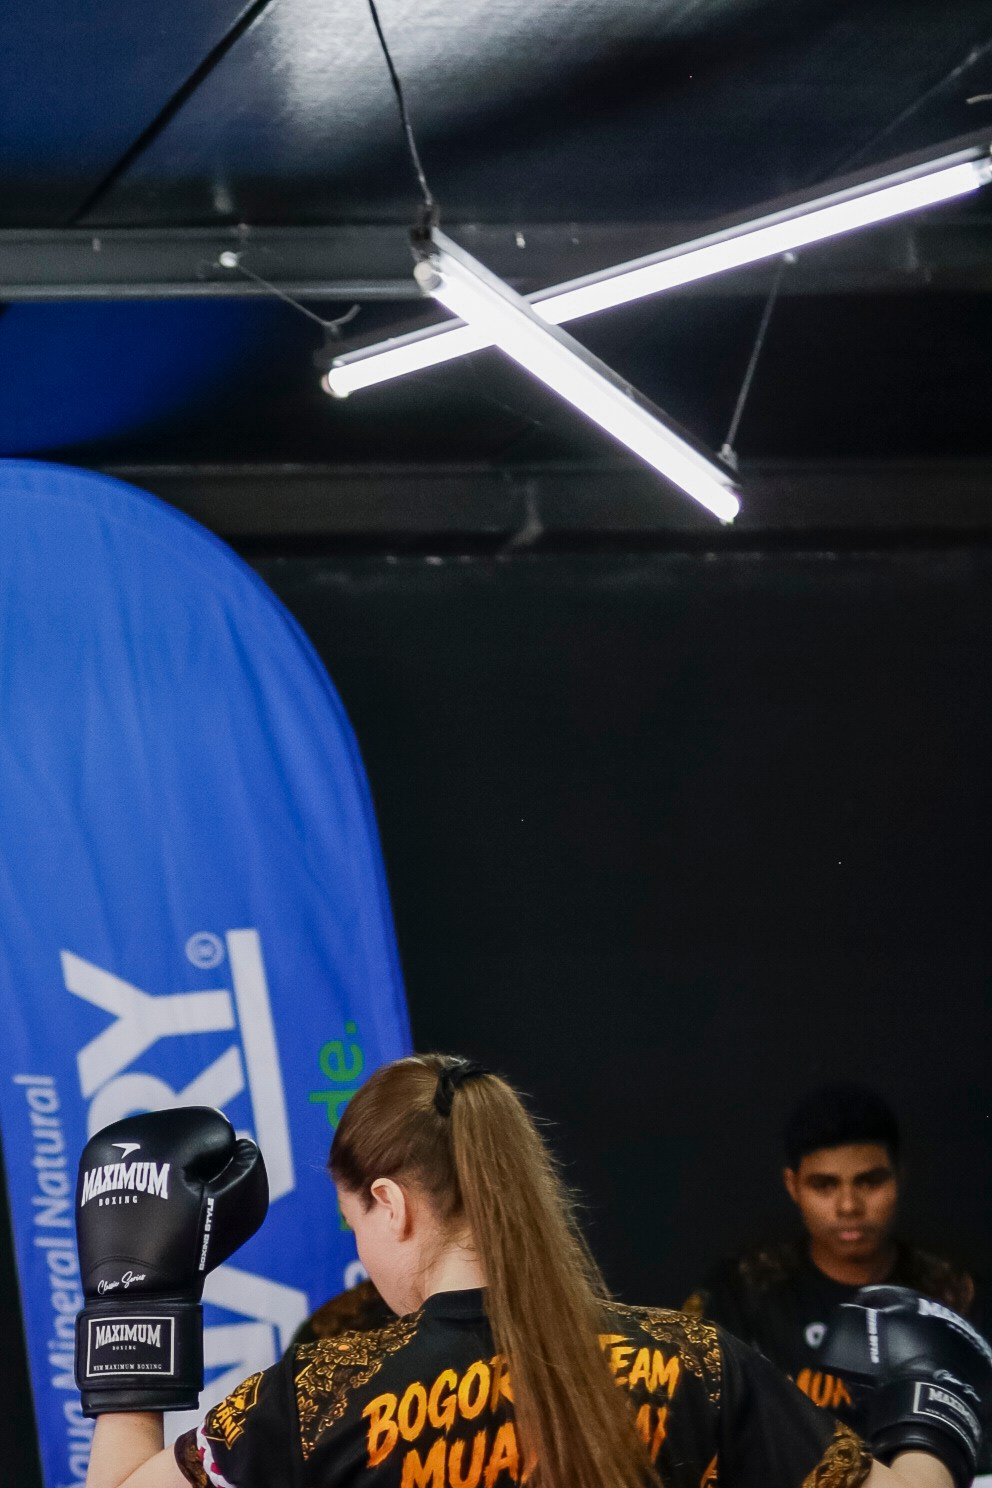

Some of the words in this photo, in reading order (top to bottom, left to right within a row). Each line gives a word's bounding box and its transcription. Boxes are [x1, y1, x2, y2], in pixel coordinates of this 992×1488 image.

[12, 1073, 73, 1228] Natural
[81, 1161, 171, 1208] MAXIMUM
[98, 1195, 138, 1207] BOXING
[198, 1233, 210, 1271] BOXING
[204, 1197, 215, 1232] STYLE
[95, 1324, 162, 1350] MAXIMUM
